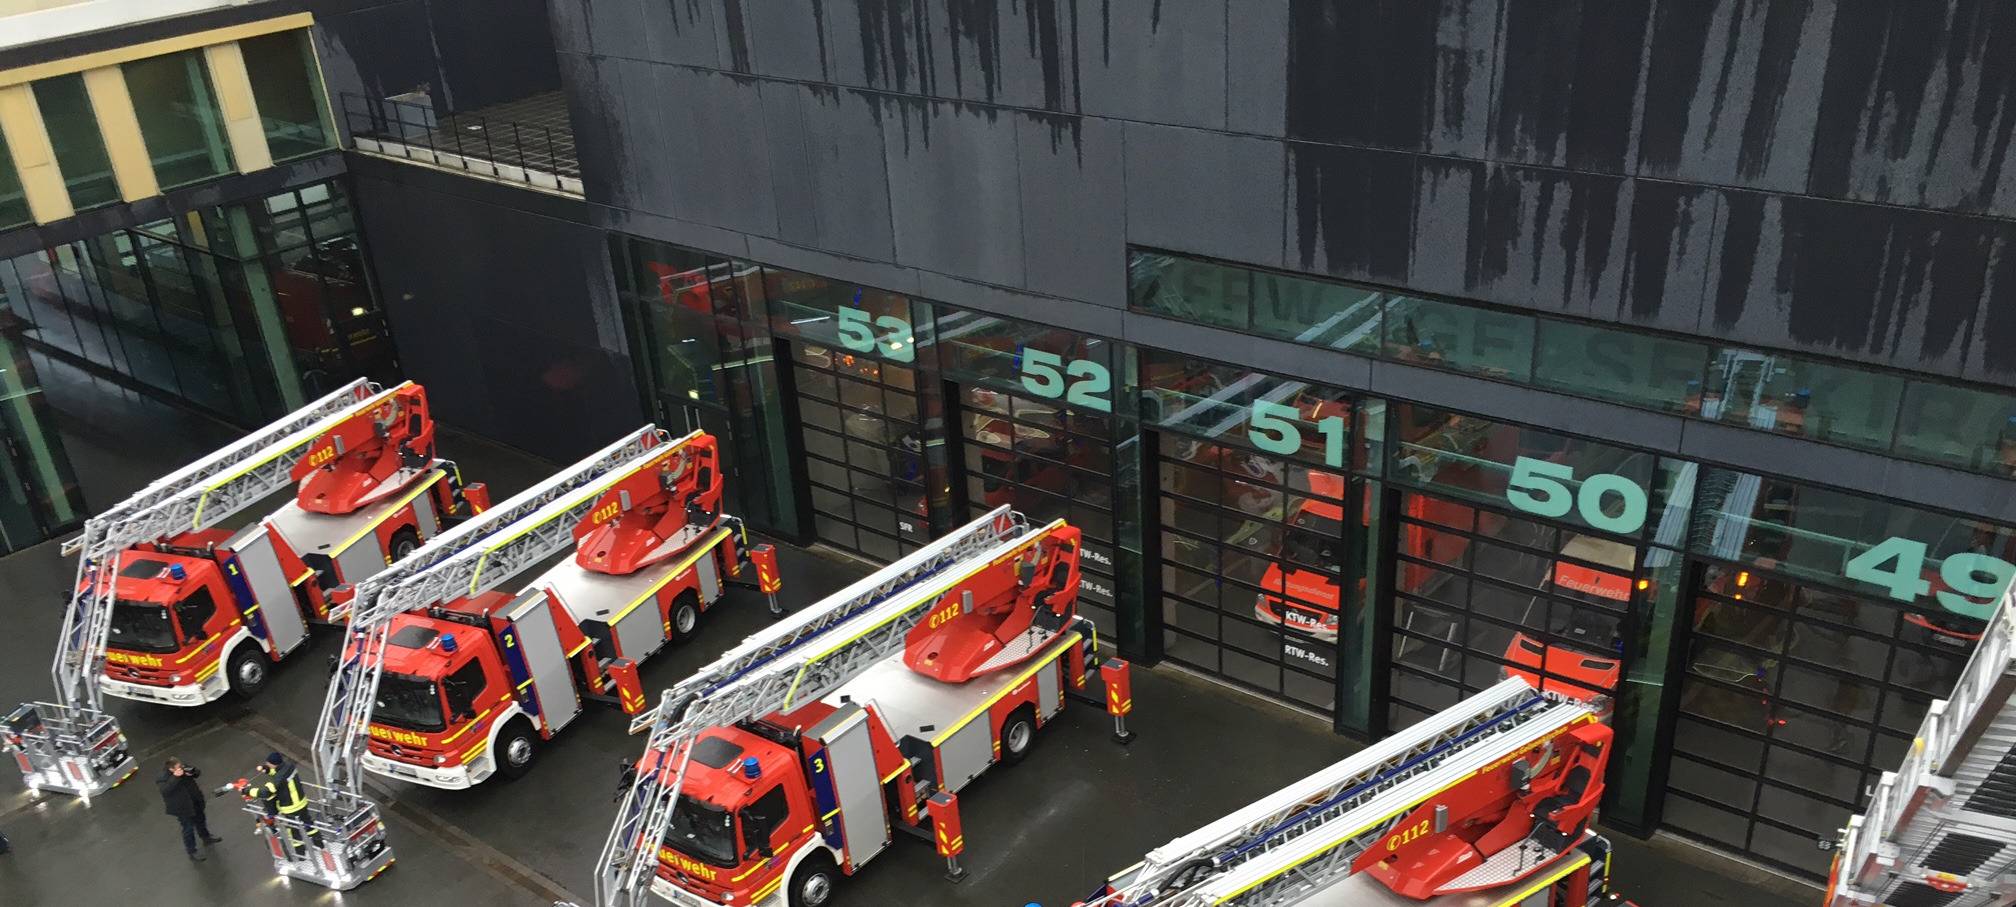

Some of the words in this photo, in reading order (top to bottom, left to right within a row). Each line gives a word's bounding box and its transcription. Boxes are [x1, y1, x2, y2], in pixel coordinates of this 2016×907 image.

[838, 305, 915, 363] 53
[1021, 347, 1112, 412] 52
[1248, 399, 1344, 468] 51
[1507, 456, 1648, 534] 50
[1080, 548, 1111, 565] TW-Res.
[228, 564, 238, 576] 1
[1846, 536, 2016, 621] 49
[1079, 579, 1113, 597] TW-Res.
[940, 603, 959, 624] 112
[504, 634, 515, 648] 2
[105, 651, 163, 667] uerwehr
[1284, 644, 1329, 667] RTW-Res.
[367, 725, 428, 747] uerwehr
[813, 758, 825, 773] 3
[1402, 820, 1430, 845] 112
[658, 848, 717, 881] uerwehr
